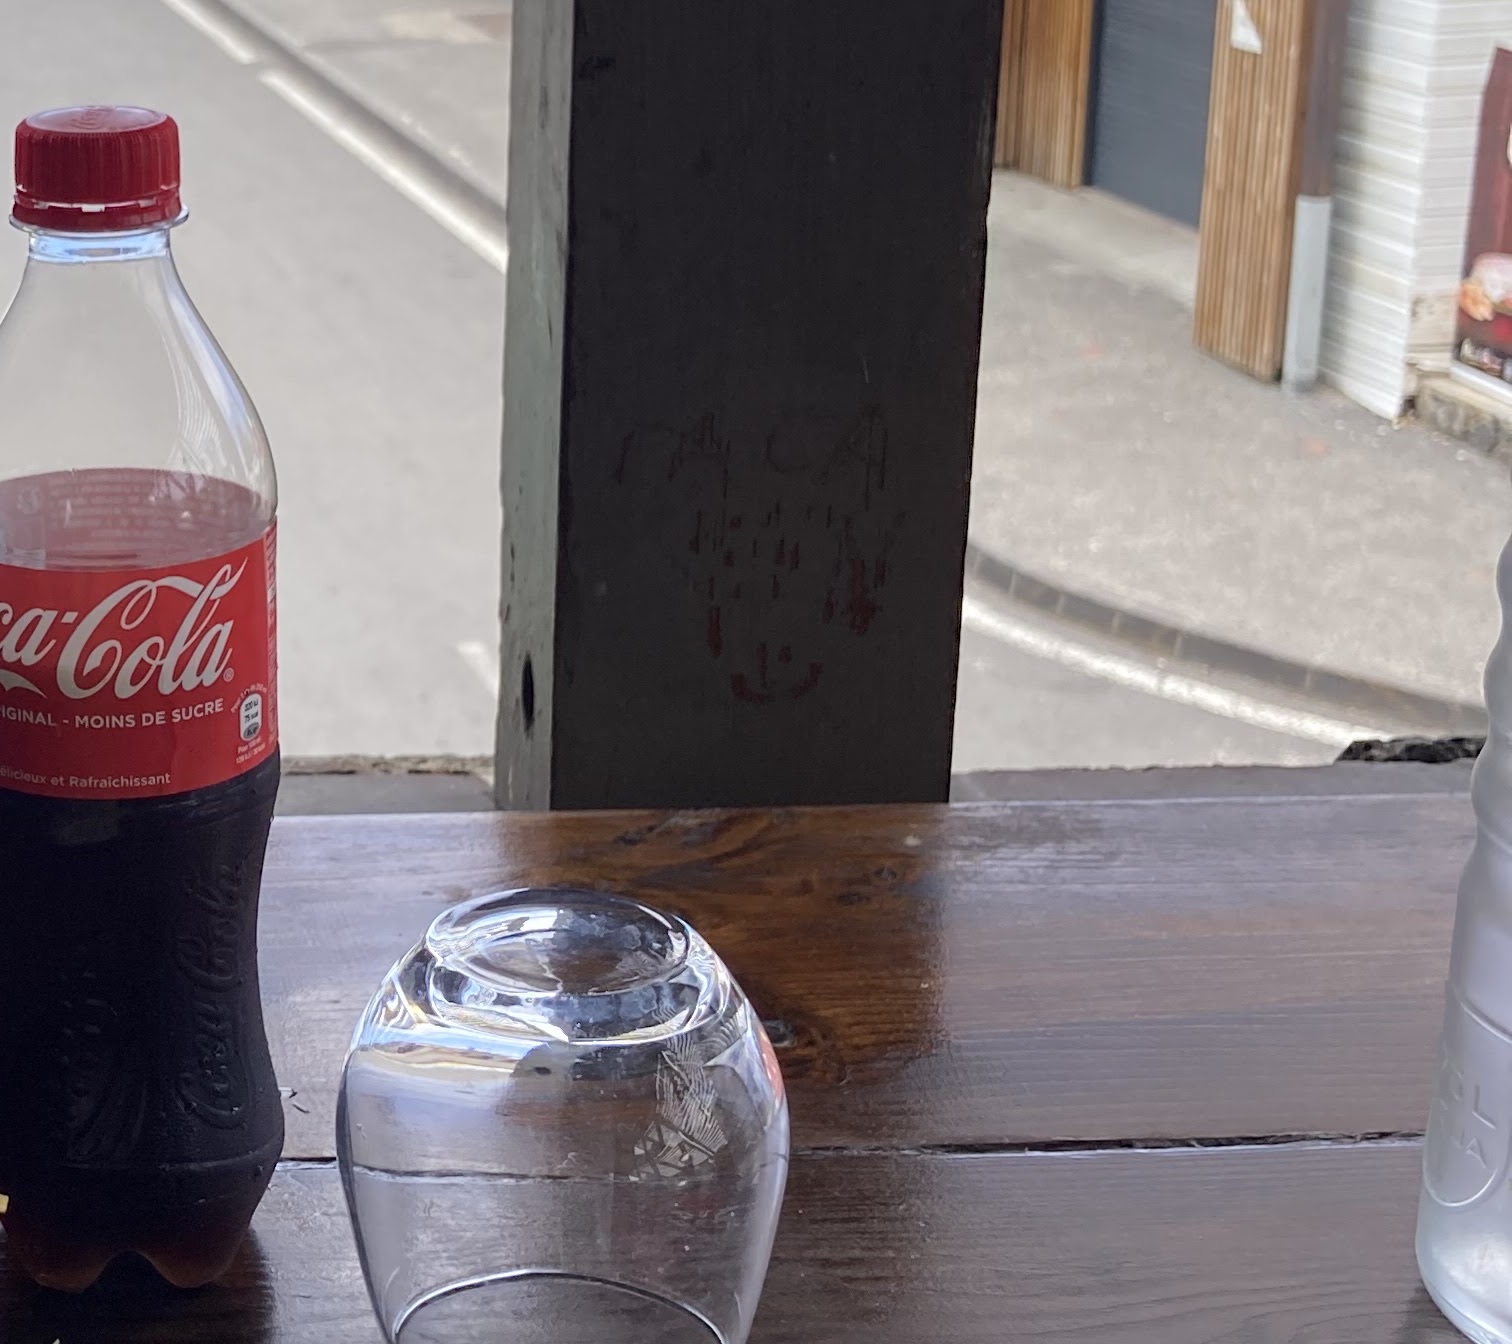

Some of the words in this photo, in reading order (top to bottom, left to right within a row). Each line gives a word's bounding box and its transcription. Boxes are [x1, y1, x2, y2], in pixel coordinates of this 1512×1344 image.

[75, 714, 136, 729] MOINS
[141, 710, 166, 727] DE
[171, 697, 224, 723] SUCRE
[50, 776, 65, 787] et
[69, 772, 171, 789] Rafraîchissant
